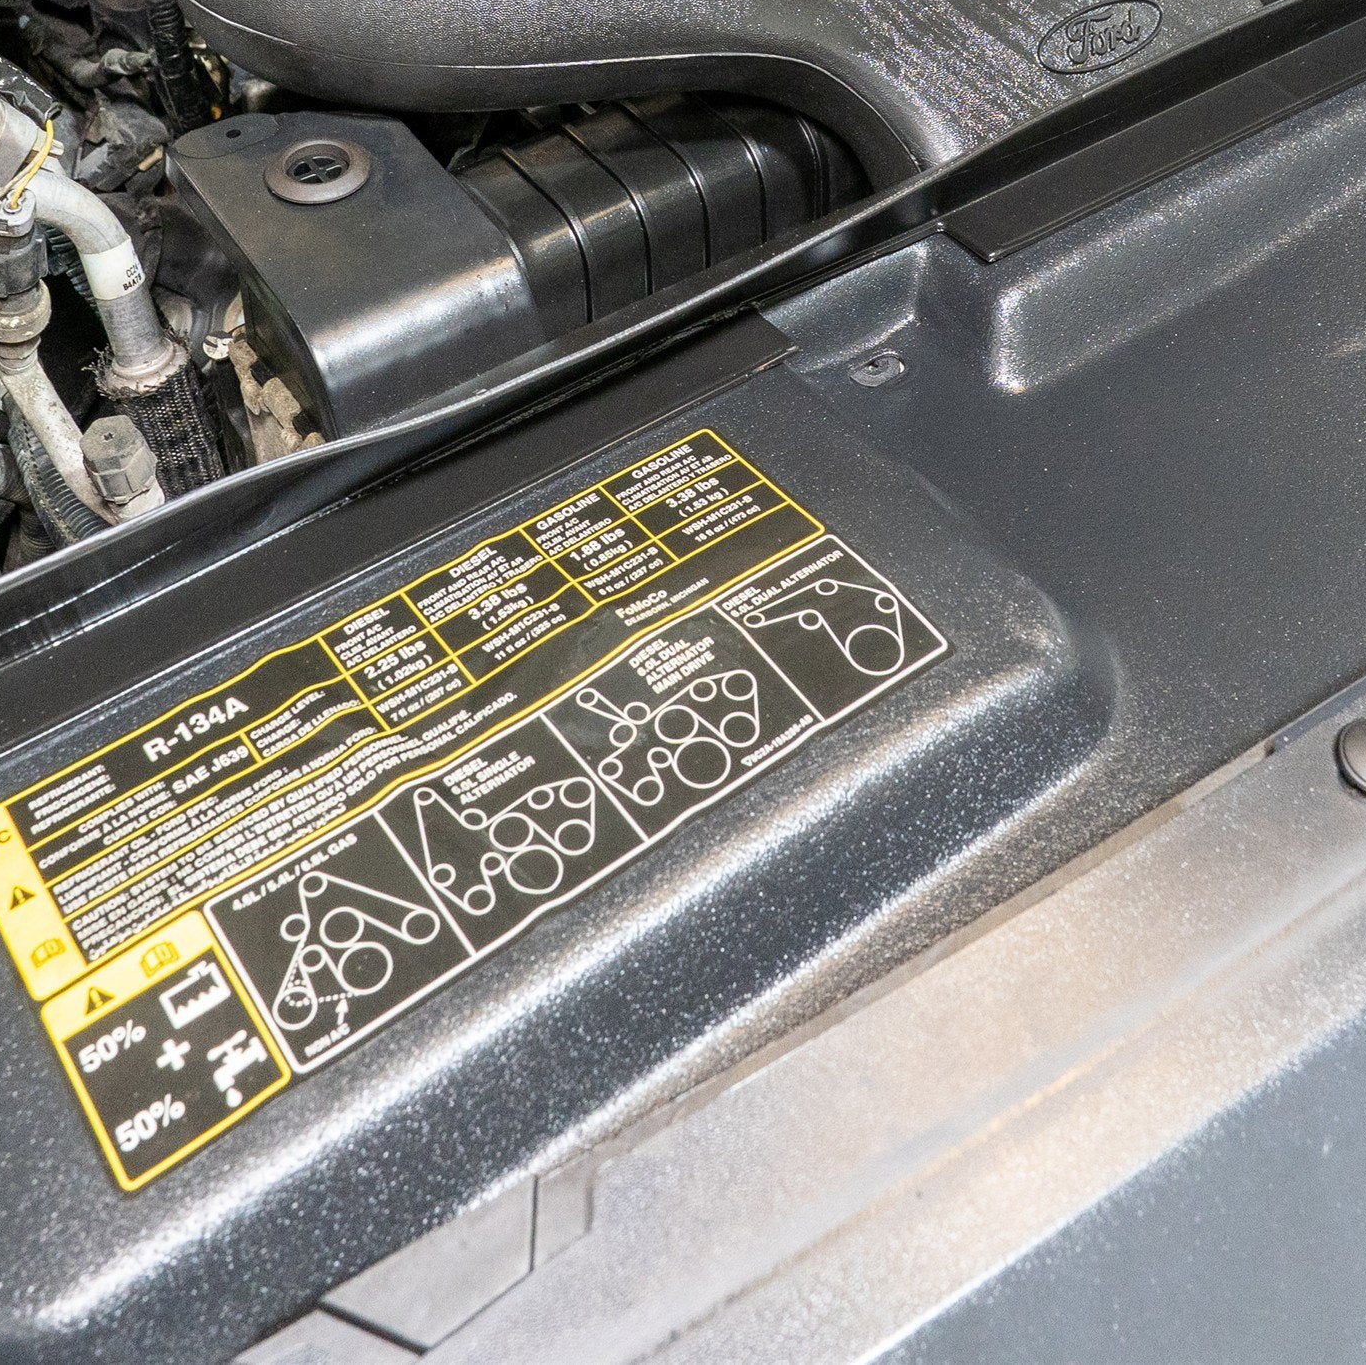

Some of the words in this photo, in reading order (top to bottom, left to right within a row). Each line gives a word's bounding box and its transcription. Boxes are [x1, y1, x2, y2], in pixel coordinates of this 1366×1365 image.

[1065, 5, 1142, 65] Ford
[615, 482, 642, 500] FRONT
[642, 473, 660, 485] AND
[659, 462, 683, 476] REAR
[682, 455, 696, 465] A/C
[631, 444, 692, 478] GASOLINE
[621, 471, 680, 505] CLIMATISATION
[679, 466, 690, 475] AV
[689, 460, 701, 469] ET
[628, 500, 643, 511] A/C
[641, 475, 689, 503] DELANTERO
[665, 488, 696, 507] 3.38
[694, 477, 719, 492] lbs
[536, 492, 600, 530] GASOLINE
[564, 519, 590, 537] AVANT
[535, 524, 564, 543] FRONT
[564, 517, 579, 528] A/C
[548, 544, 563, 555] A/C
[562, 517, 611, 547] DELANTERO
[569, 540, 601, 560] 1.88
[599, 528, 625, 544] lbs
[448, 546, 497, 578] DIESEL
[486, 569, 498, 580] AV
[750, 585, 782, 606] DUAL
[780, 549, 843, 589] ALTERNATOR
[416, 587, 451, 609] FRONT
[447, 578, 466, 592] AND
[465, 564, 491, 581] REAR
[490, 555, 506, 568] A/C
[669, 577, 709, 603] MICHIGAN
[721, 586, 761, 611] DIESEL
[429, 610, 445, 622] A/C
[443, 581, 496, 613] DELANTERO
[467, 594, 501, 620] 3.38
[500, 582, 527, 599] lbs
[614, 589, 667, 622] FoMoCo
[334, 631, 365, 653] FRONT
[366, 623, 382, 636] A/C
[342, 607, 390, 634] DIESEL
[365, 626, 394, 647] AVANT
[346, 654, 362, 667] A/C
[361, 624, 416, 658] DELANTERO
[363, 653, 399, 679] 2.25
[397, 640, 426, 659] lbs
[628, 638, 673, 668] DIESEL
[640, 636, 714, 685] ALTERNATOR
[657, 638, 690, 660] DUAL
[651, 670, 682, 694] MAIN
[679, 650, 715, 676] DRIVE
[142, 696, 249, 761] R-134A
[249, 710, 292, 739] CHARGE
[290, 690, 325, 714] LEVEL:
[255, 718, 301, 748] CHARGE:
[262, 733, 299, 756] CARGA
[296, 721, 316, 736] DE
[171, 765, 210, 793] SAE
[211, 745, 248, 772] J639
[442, 757, 488, 786] DIESEL
[459, 755, 535, 805] ALTERNATOR
[475, 750, 520, 782] SINGLE
[78, 1018, 146, 1073] 50%
[114, 1093, 185, 1152] 50%
